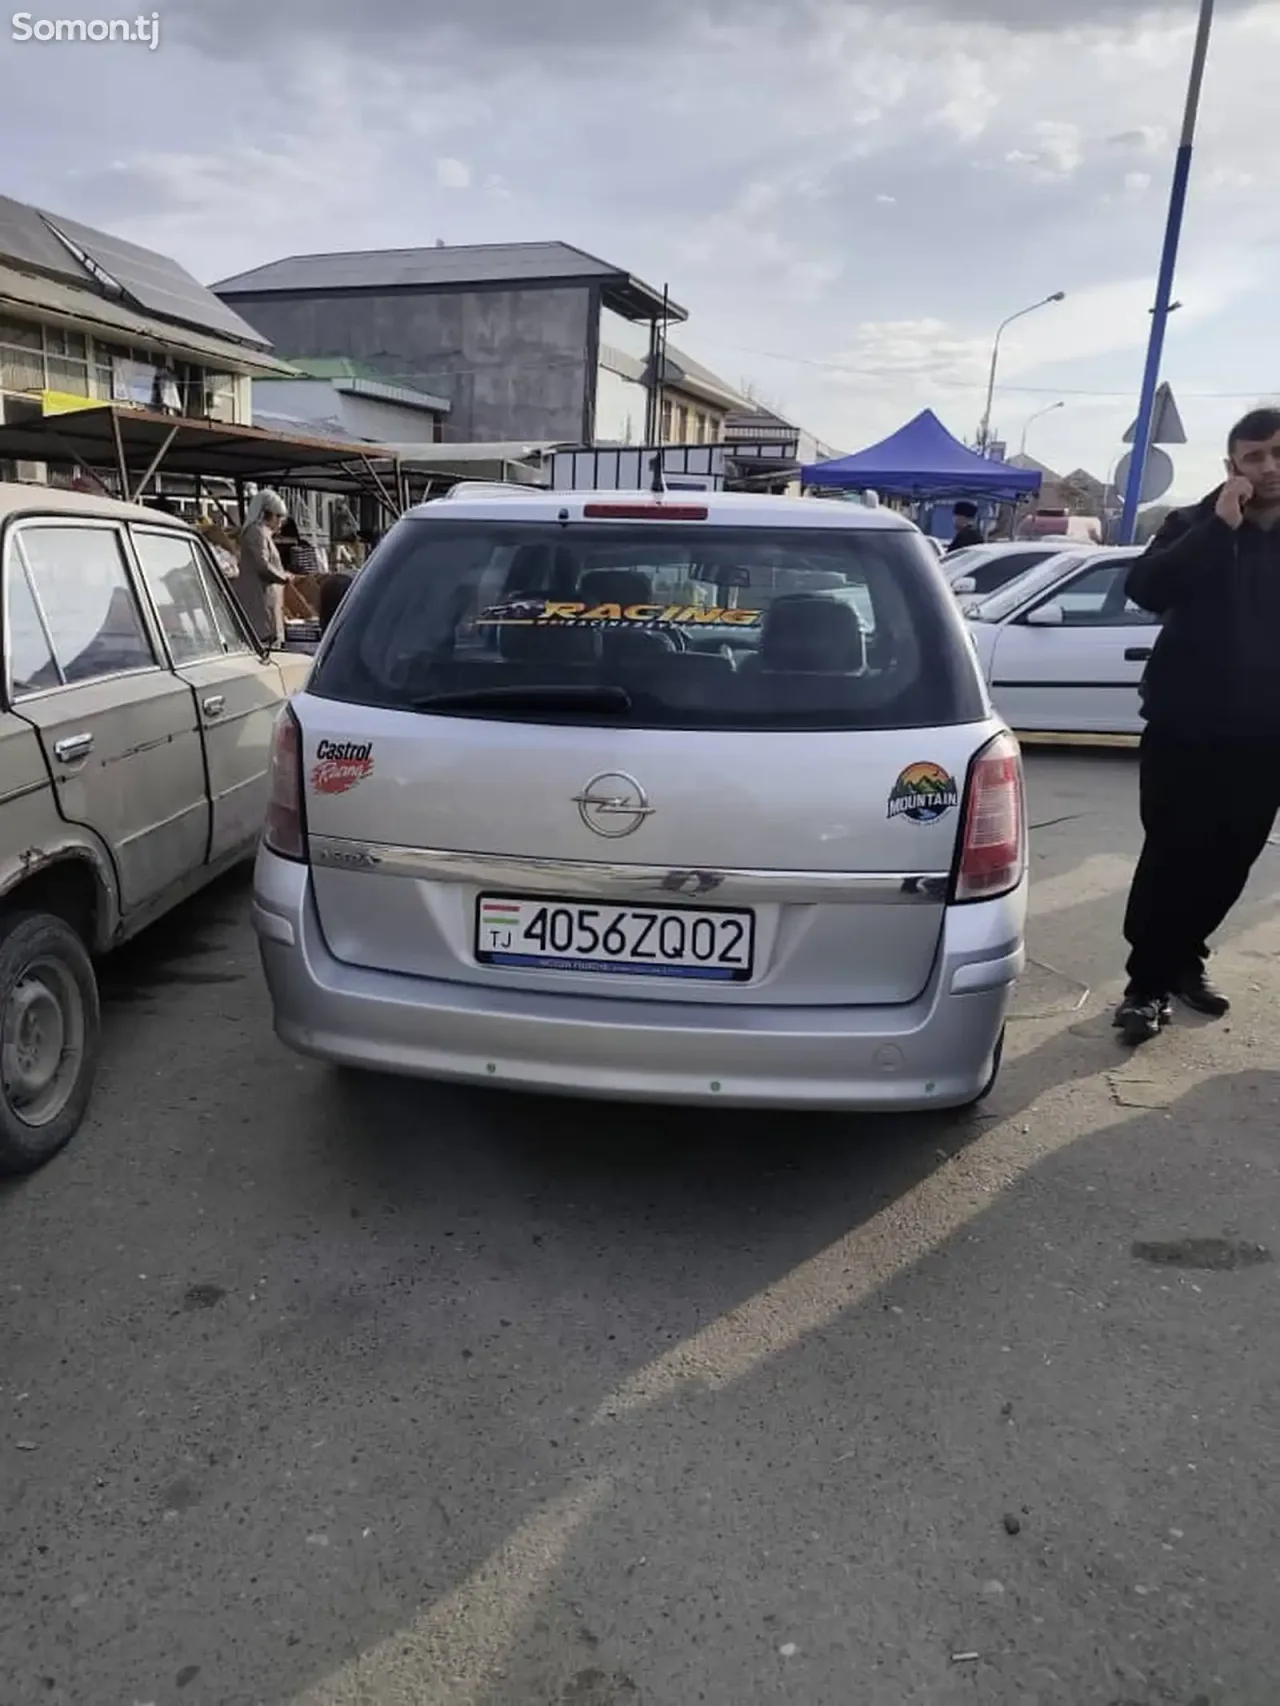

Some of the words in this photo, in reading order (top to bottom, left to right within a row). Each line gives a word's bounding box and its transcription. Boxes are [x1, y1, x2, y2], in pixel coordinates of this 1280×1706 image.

[537, 601, 763, 624] RACING
[316, 739, 373, 761] Castrol
[889, 791, 958, 815] MOUNTAIN
[489, 930, 512, 949] TJ
[523, 907, 745, 963] 4056ZQ02
